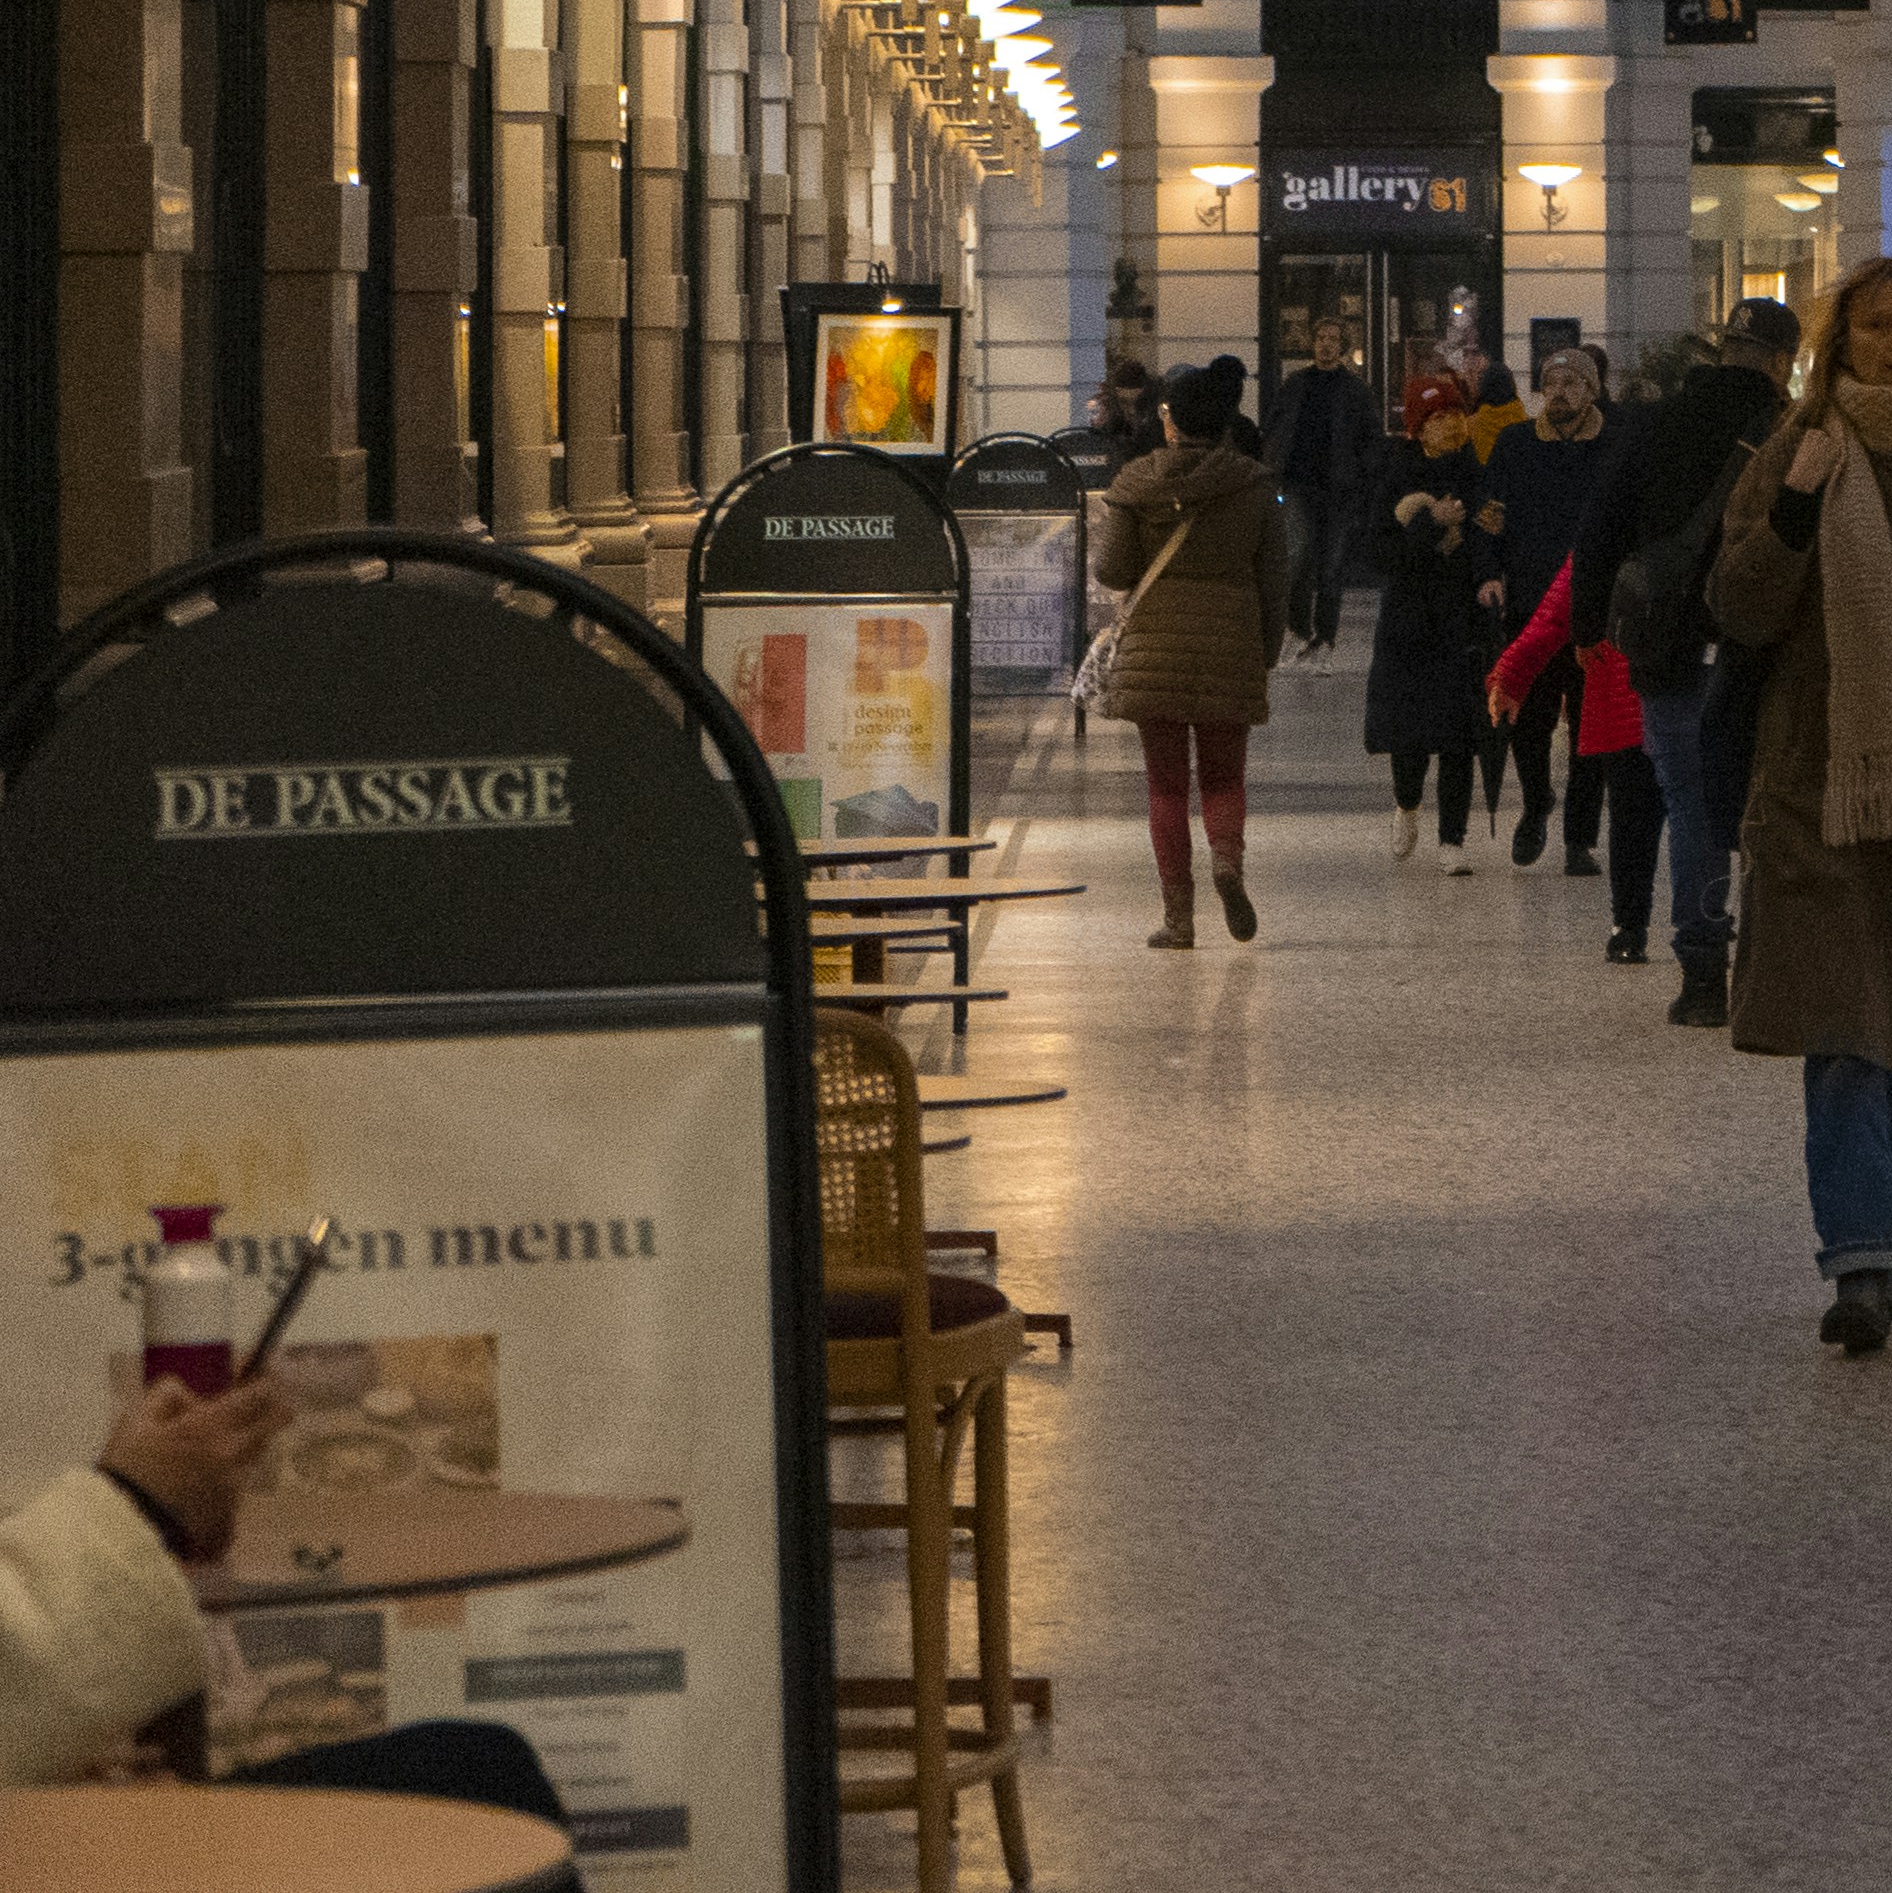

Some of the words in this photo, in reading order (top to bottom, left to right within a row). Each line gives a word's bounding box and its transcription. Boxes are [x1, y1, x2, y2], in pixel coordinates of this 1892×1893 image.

[997, 469, 1048, 484] PASSAGE
[765, 518, 794, 539] DE
[802, 517, 895, 539] PASSAGE
[156, 772, 252, 834] DE
[275, 763, 573, 828] PASSAGE
[427, 1214, 658, 1270] menu
